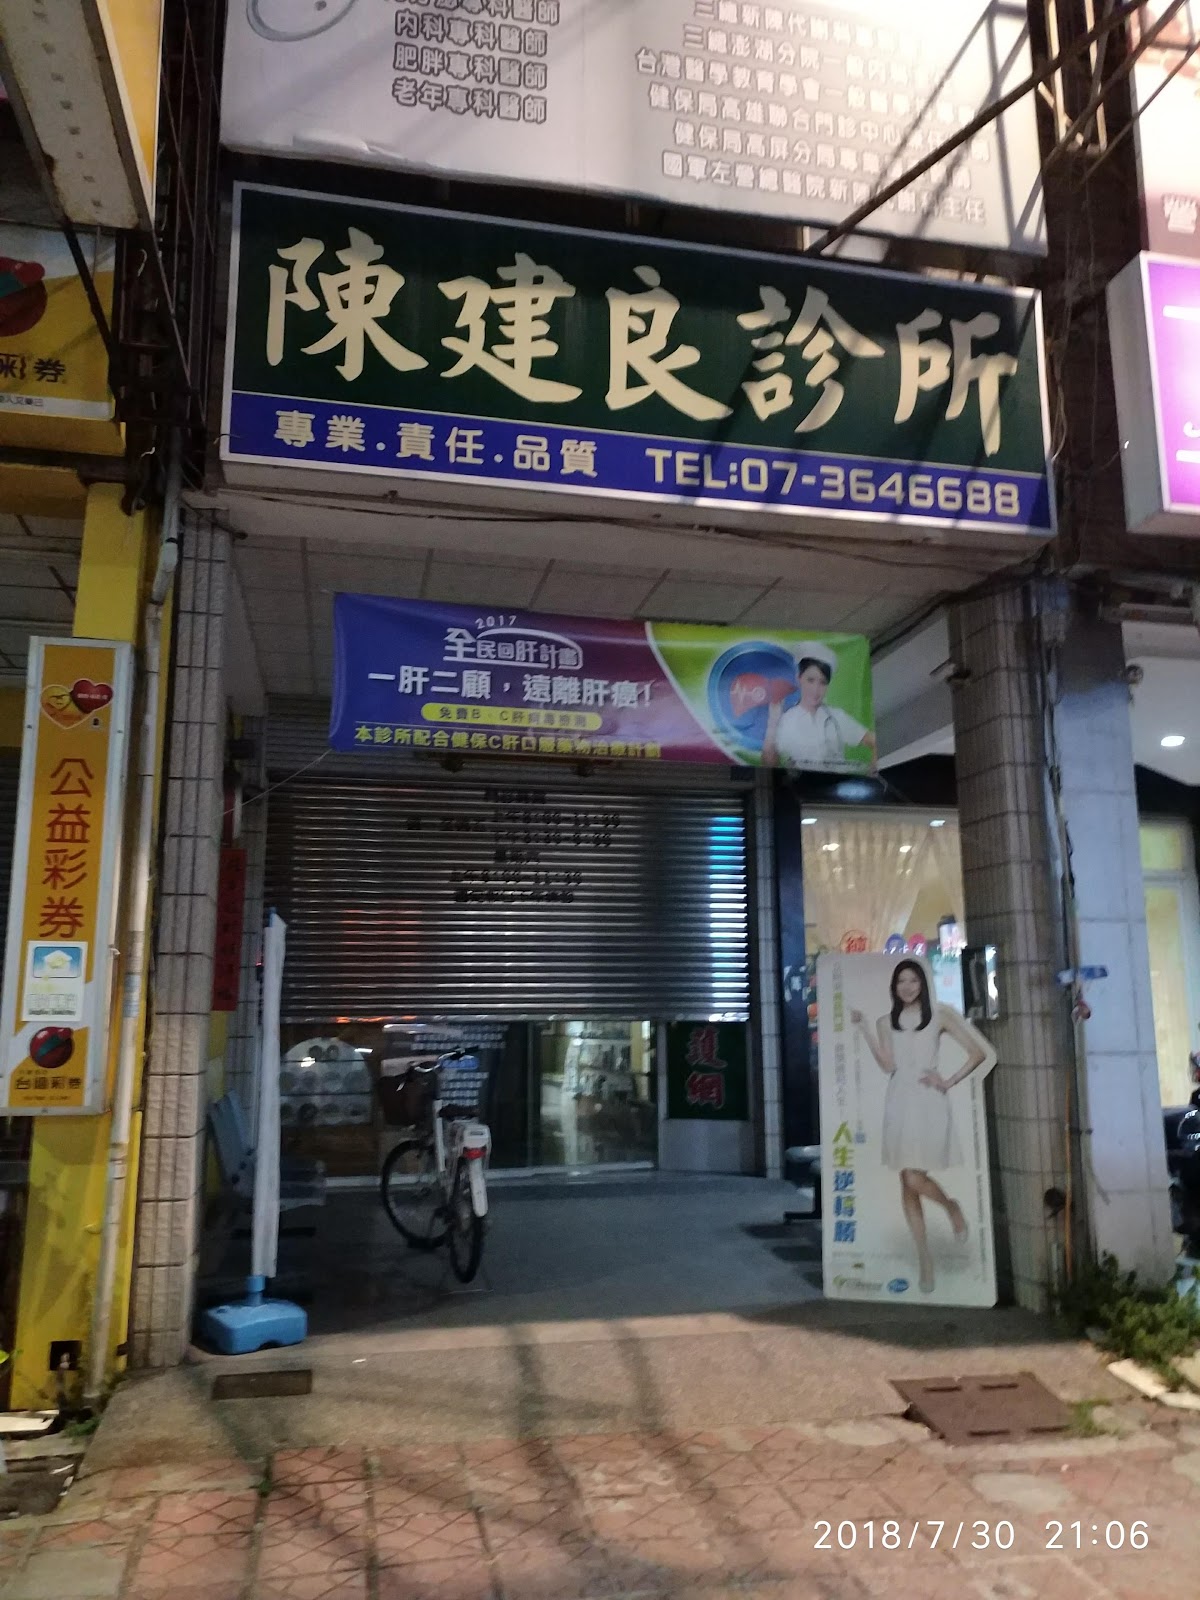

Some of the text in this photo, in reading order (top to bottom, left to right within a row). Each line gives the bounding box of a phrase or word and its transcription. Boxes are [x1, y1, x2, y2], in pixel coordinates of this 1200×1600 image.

[394, 9, 548, 57] 內科專科醫師
[393, 42, 548, 91] 肥胖專科醫師
[392, 76, 548, 124] 老年專科醫師
[266, 226, 1018, 456] 陳建良診所
[645, 446, 1021, 518] TEL:07-3646688
[475, 614, 518, 630] 2017
[39, 757, 95, 939] 公益彩券
